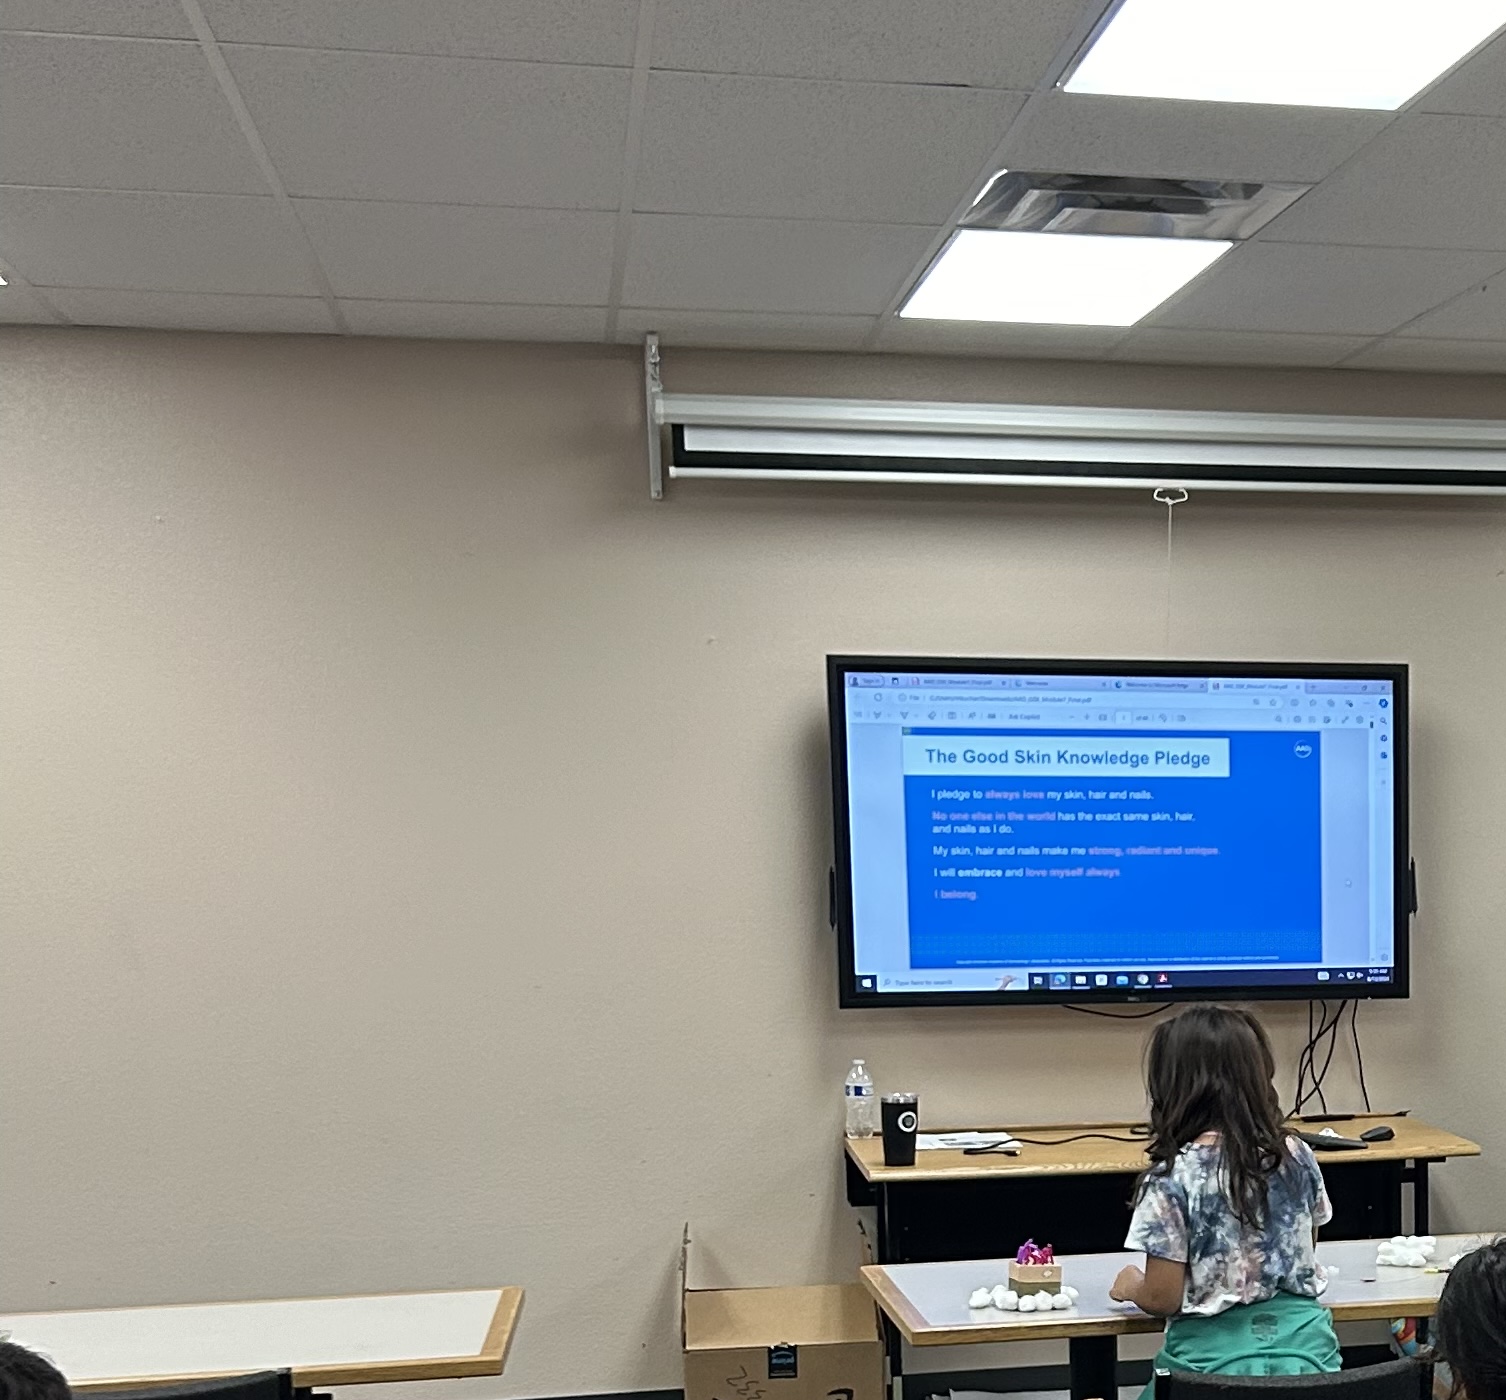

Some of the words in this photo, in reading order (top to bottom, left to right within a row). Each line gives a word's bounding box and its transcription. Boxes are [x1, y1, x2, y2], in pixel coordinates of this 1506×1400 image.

[925, 749, 958, 764] The
[963, 749, 1009, 764] Good
[1014, 749, 1052, 765] Skin
[1057, 750, 1150, 769] Knowledge
[1155, 751, 1211, 769] Pledge
[931, 789, 936, 799] I
[937, 789, 971, 802] pledge
[972, 789, 984, 800] to
[985, 789, 1021, 802] always
[1047, 791, 1063, 802] my
[1064, 790, 1087, 802] skin,
[1088, 790, 1107, 800] hair
[1109, 790, 1128, 800] and
[1129, 790, 1155, 800] nails.
[949, 812, 970, 822] one
[995, 811, 1006, 821] in
[1007, 811, 1025, 822] the
[1027, 811, 1056, 822] world
[1057, 811, 1076, 822] has
[1077, 811, 1094, 822] the
[1095, 812, 1121, 822] exact
[1122, 813, 1150, 822] same
[1151, 812, 1174, 823] skin,
[932, 823, 952, 834] and
[953, 823, 977, 834] nails
[978, 825, 992, 834] as
[993, 824, 997, 834] I
[998, 824, 1015, 834] do.
[933, 846, 949, 858] My
[950, 846, 974, 857] skin,
[975, 846, 995, 856] hair
[996, 846, 1016, 856] and
[1017, 846, 1041, 856] nails
[1042, 846, 1069, 856] make
[1070, 847, 1087, 856] me
[1163, 846, 1182, 856] and
[934, 868, 938, 877] I
[939, 867, 956, 877] will
[957, 867, 1003, 878] embrace
[1004, 867, 1024, 877] and
[1025, 867, 1048, 878] love
